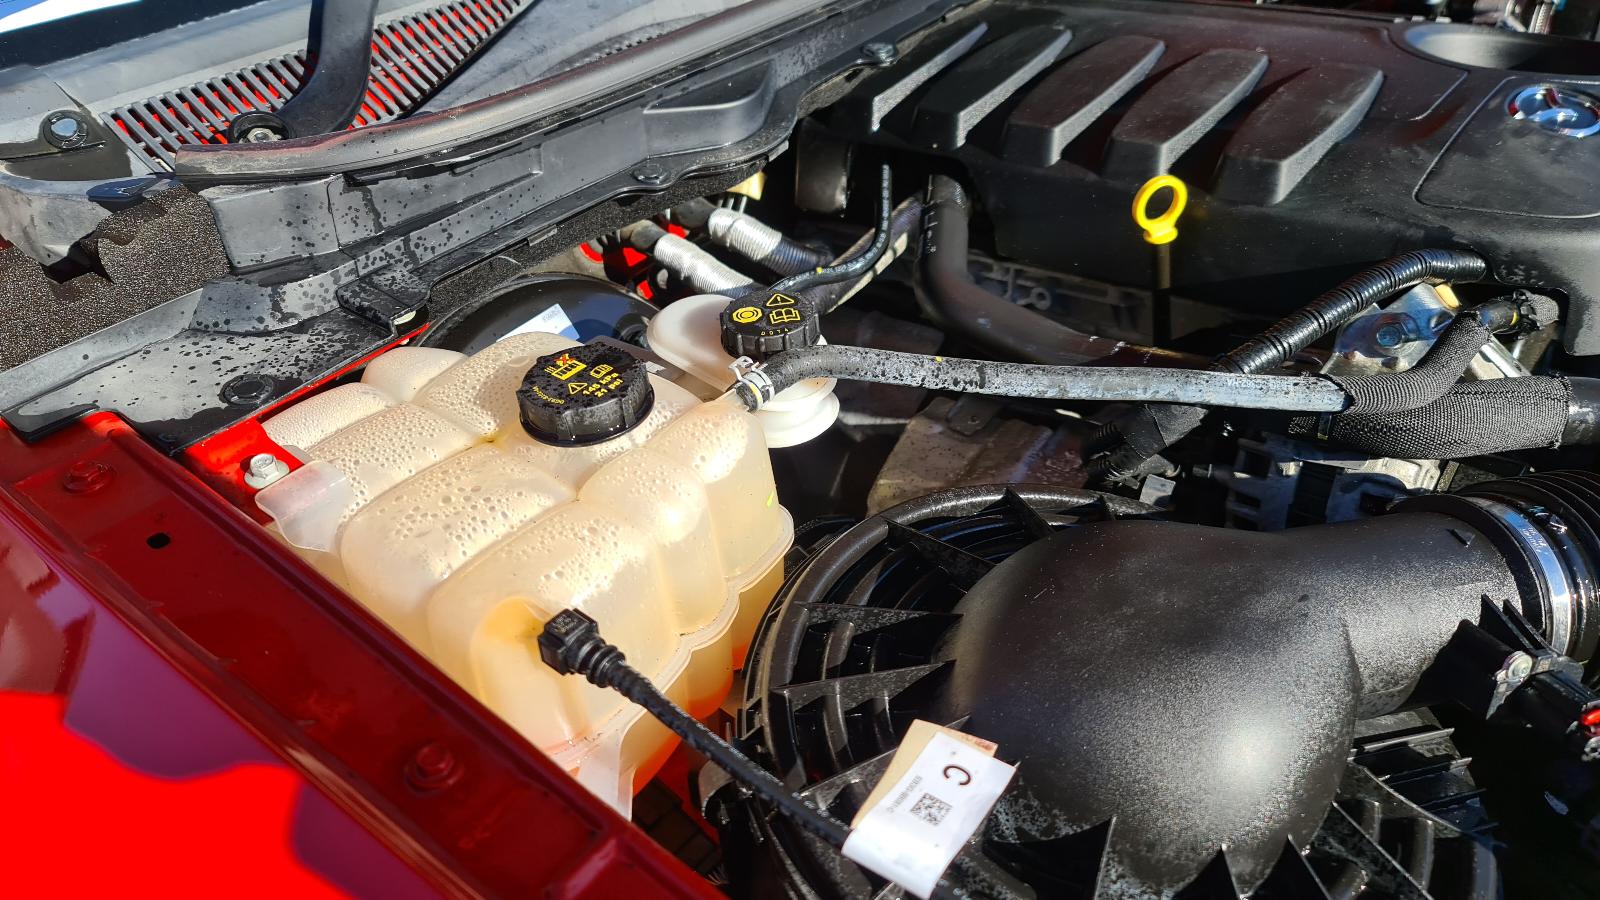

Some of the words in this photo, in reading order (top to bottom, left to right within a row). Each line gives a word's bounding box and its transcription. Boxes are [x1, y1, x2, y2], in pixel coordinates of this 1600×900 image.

[583, 383, 600, 395] 145
[599, 373, 619, 384] kPa
[594, 389, 608, 398] 21
[608, 378, 624, 390] psi
[943, 765, 972, 786] C
